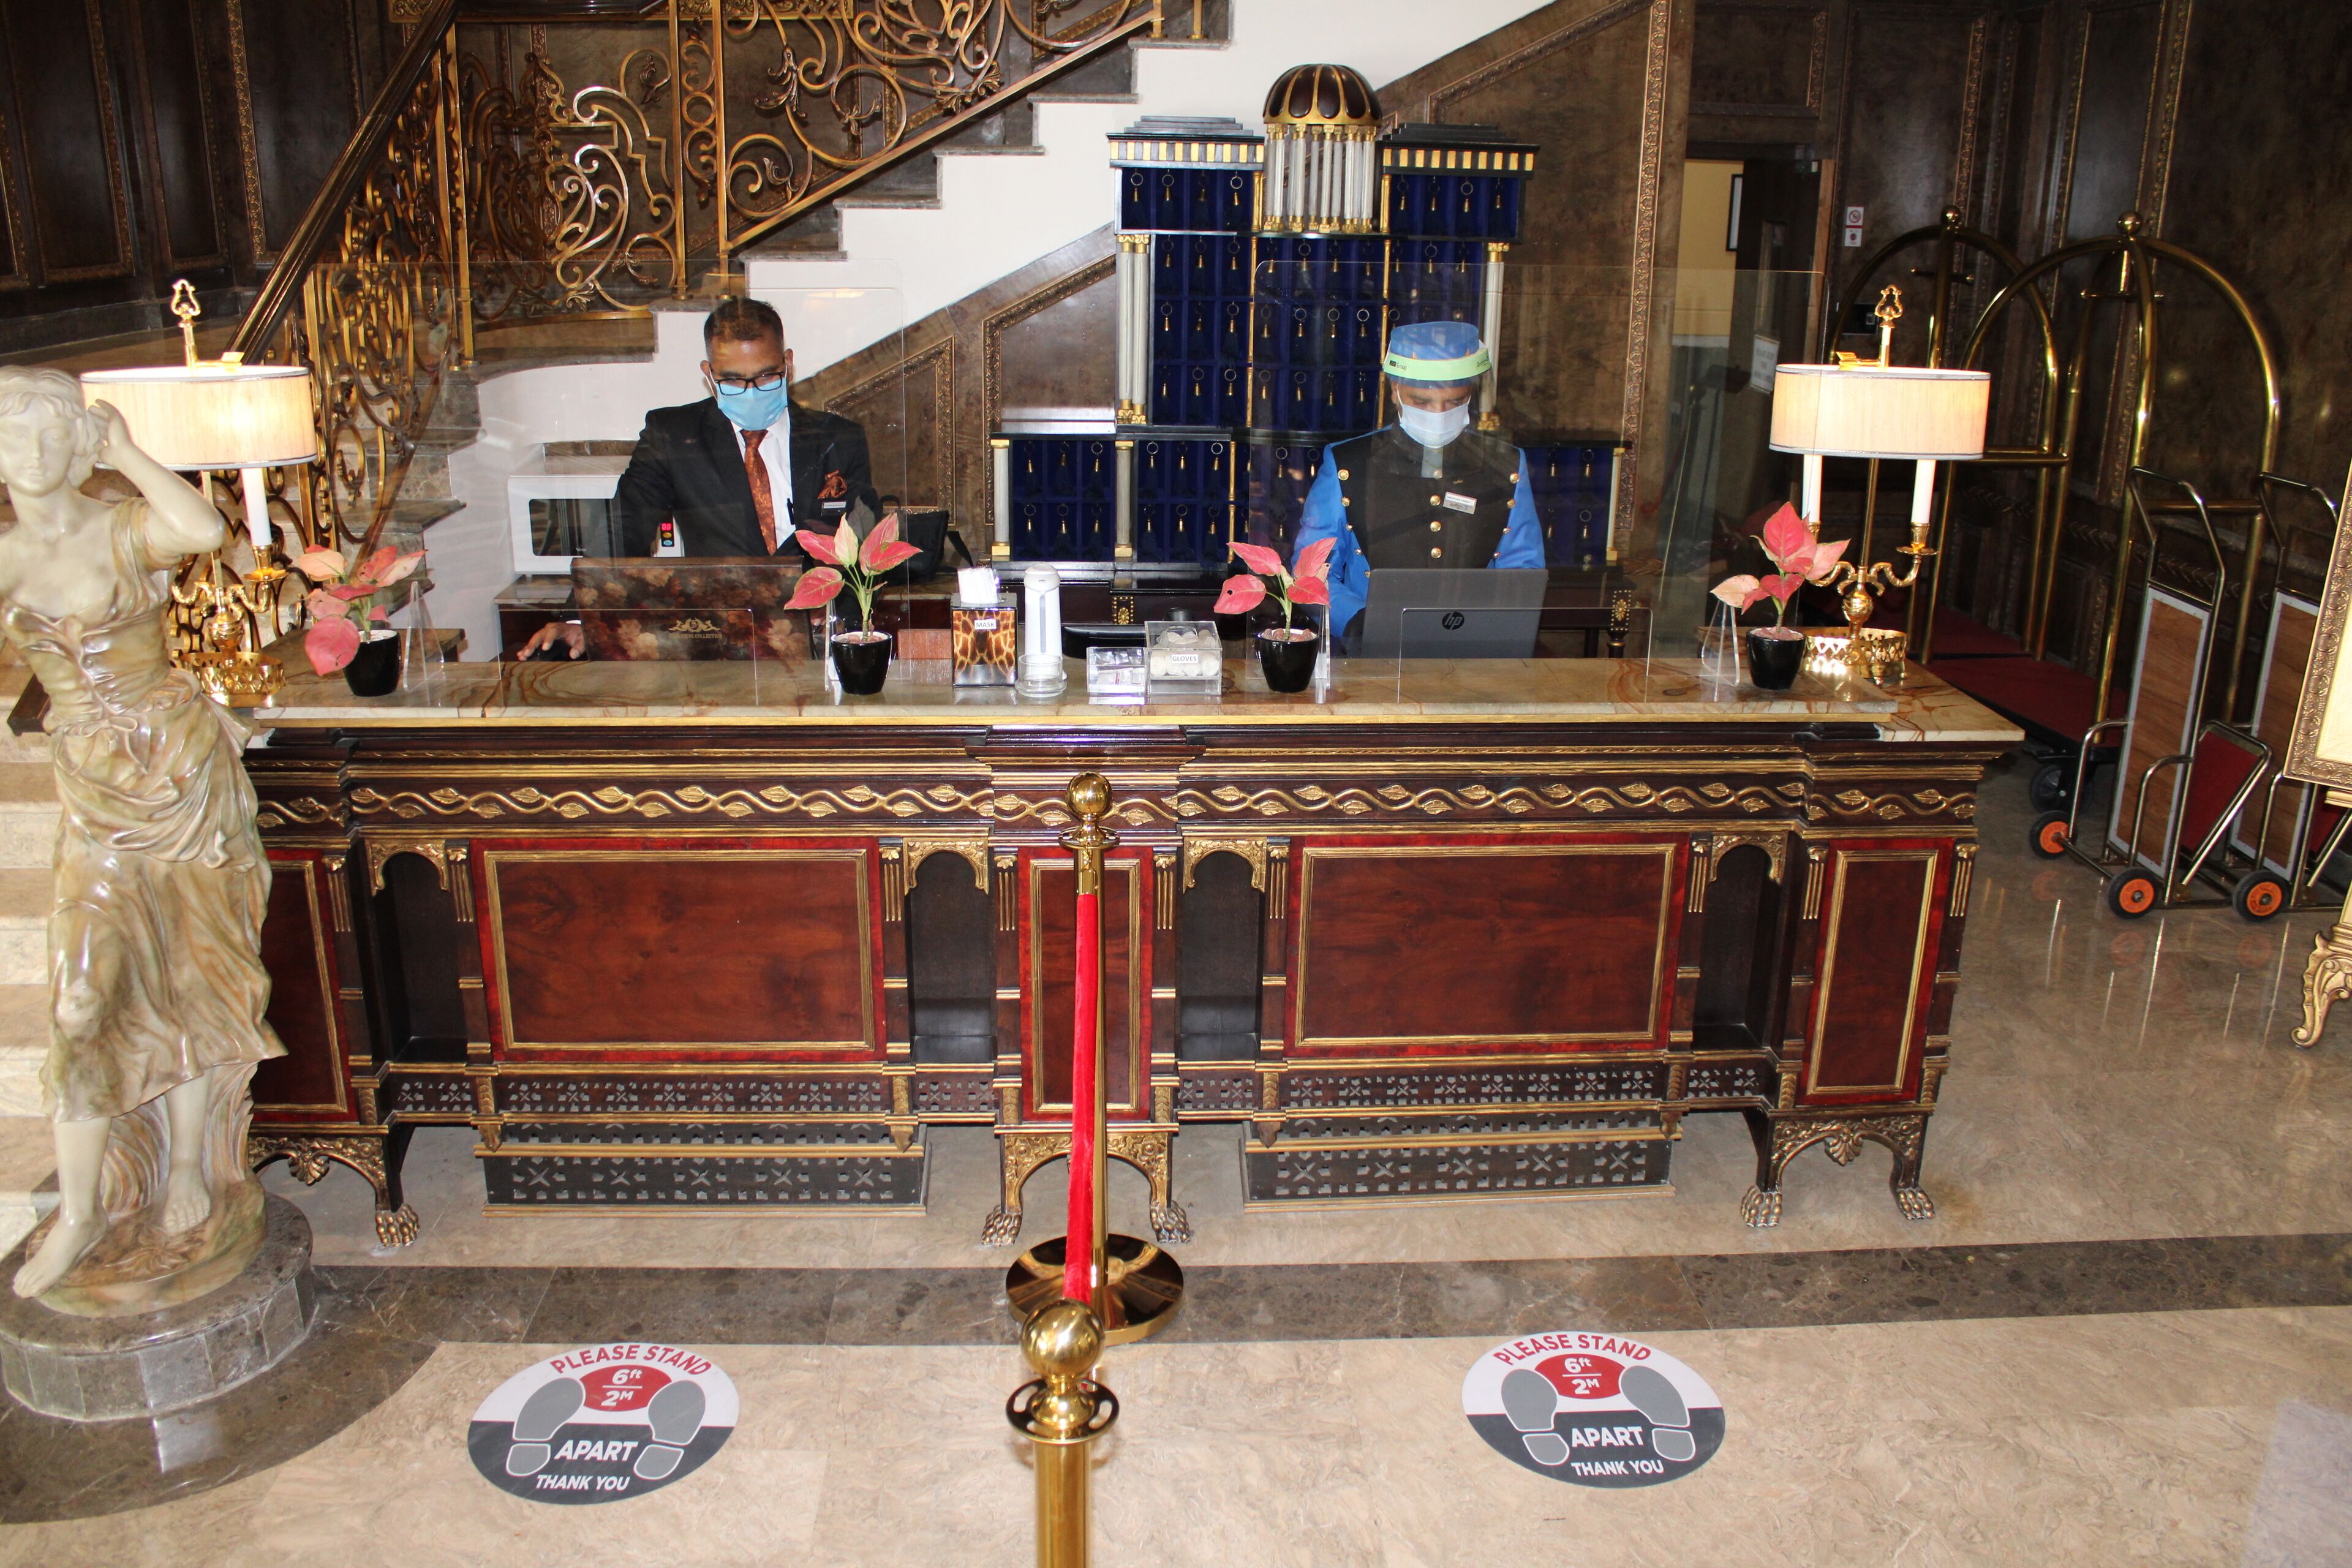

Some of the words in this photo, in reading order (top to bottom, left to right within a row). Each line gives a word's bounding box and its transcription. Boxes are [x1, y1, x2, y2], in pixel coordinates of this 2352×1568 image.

[1444, 611, 1463, 630] hp
[1493, 1334, 1573, 1366] PLEASE
[1577, 1334, 1652, 1362] STAND
[551, 1344, 640, 1374] PLEASE
[643, 1345, 712, 1376] STAND
[1564, 1357, 1592, 1373] 6ft
[611, 1368, 643, 1385] 6ft
[1570, 1426, 1644, 1447] APART
[554, 1439, 639, 1461] APART
[1570, 1461, 1629, 1476] THANK
[1630, 1459, 1664, 1475] YOU
[535, 1474, 592, 1490] THANK
[595, 1476, 630, 1491] YOU
